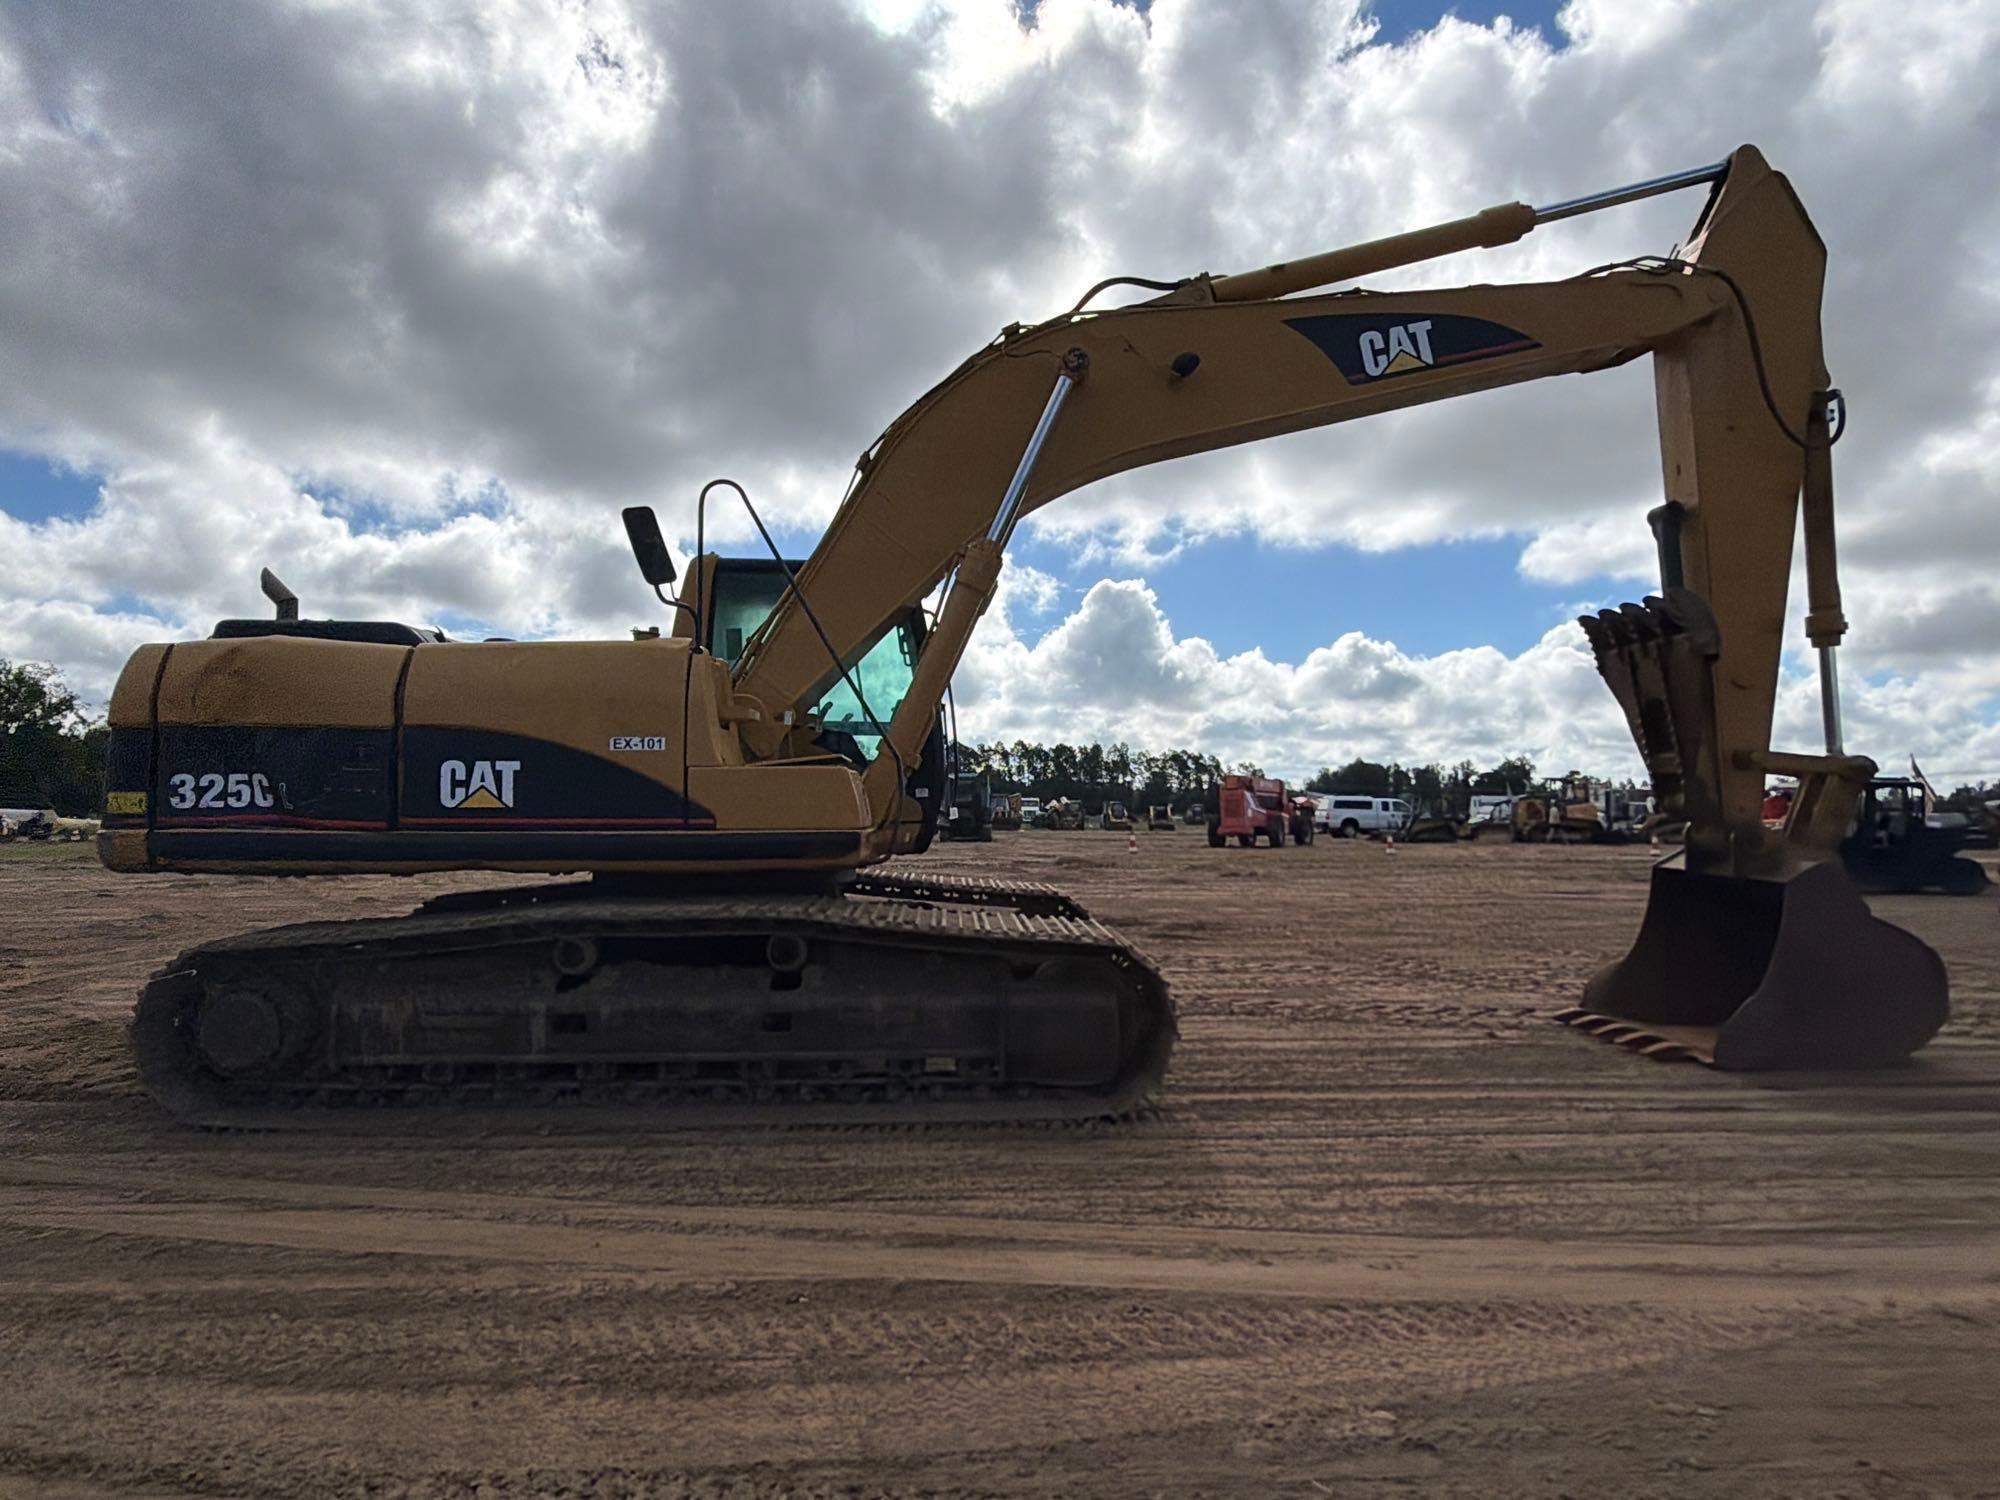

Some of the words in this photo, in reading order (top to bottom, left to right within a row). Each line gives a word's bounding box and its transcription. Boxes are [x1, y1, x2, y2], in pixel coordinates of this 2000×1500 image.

[1358, 319, 1434, 377] CAT
[612, 738, 664, 750] EX-101
[440, 759, 521, 808] CAT
